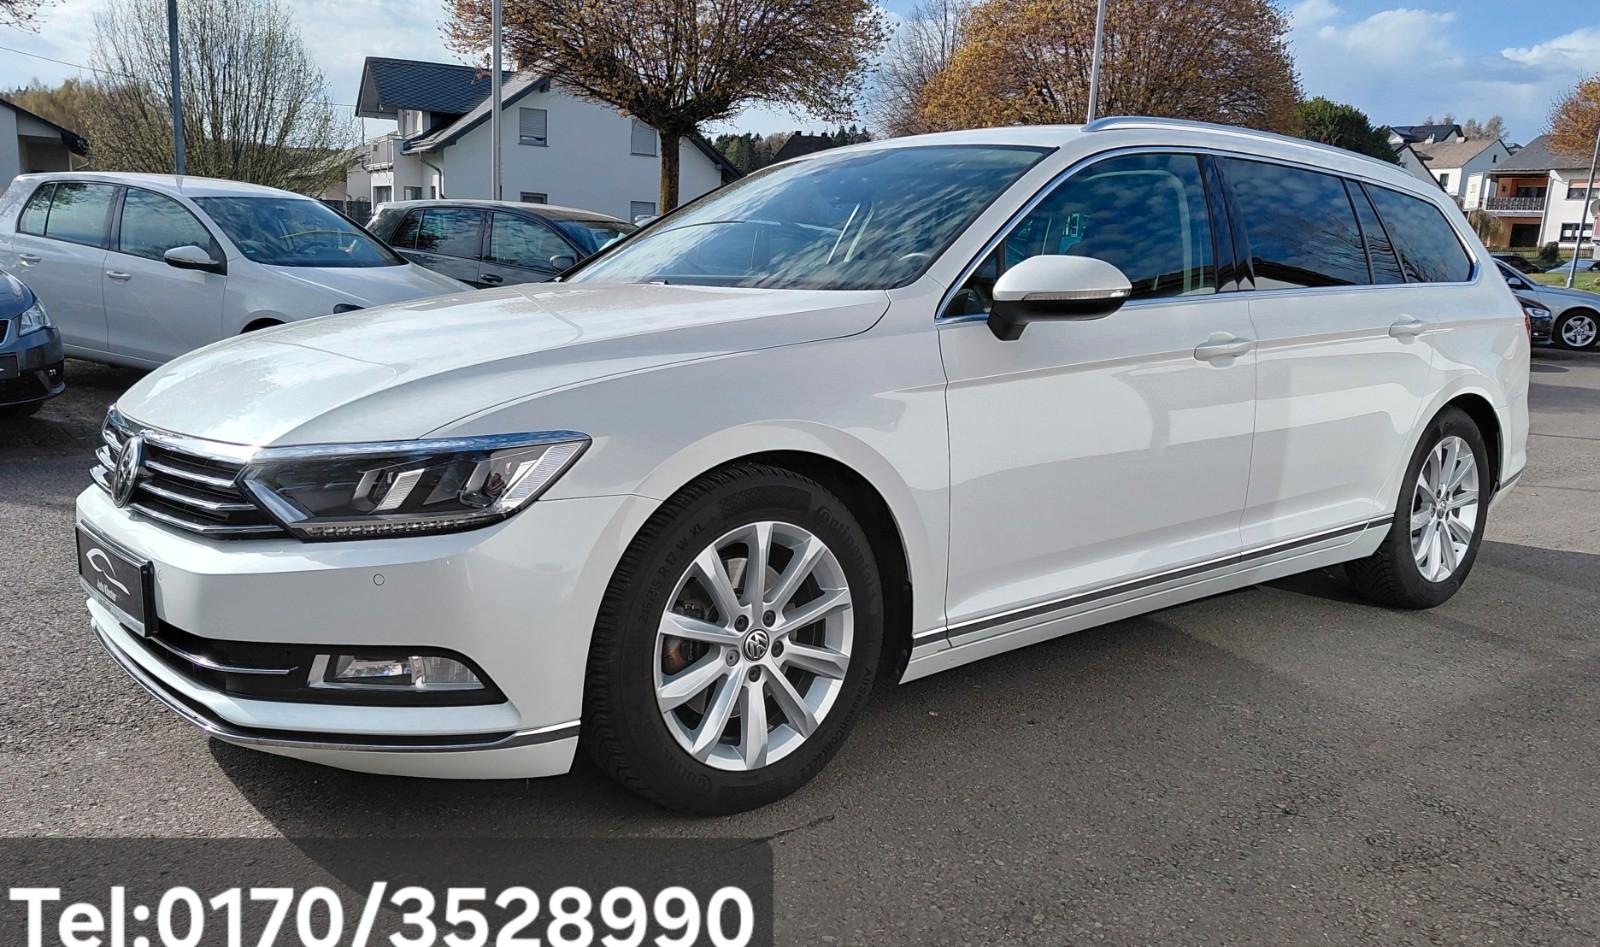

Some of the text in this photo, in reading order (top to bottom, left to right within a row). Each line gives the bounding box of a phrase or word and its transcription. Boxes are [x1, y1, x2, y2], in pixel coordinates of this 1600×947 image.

[658, 567, 669, 577] R
[665, 551, 678, 566] 17
[675, 535, 689, 551] W
[689, 522, 706, 537] XL
